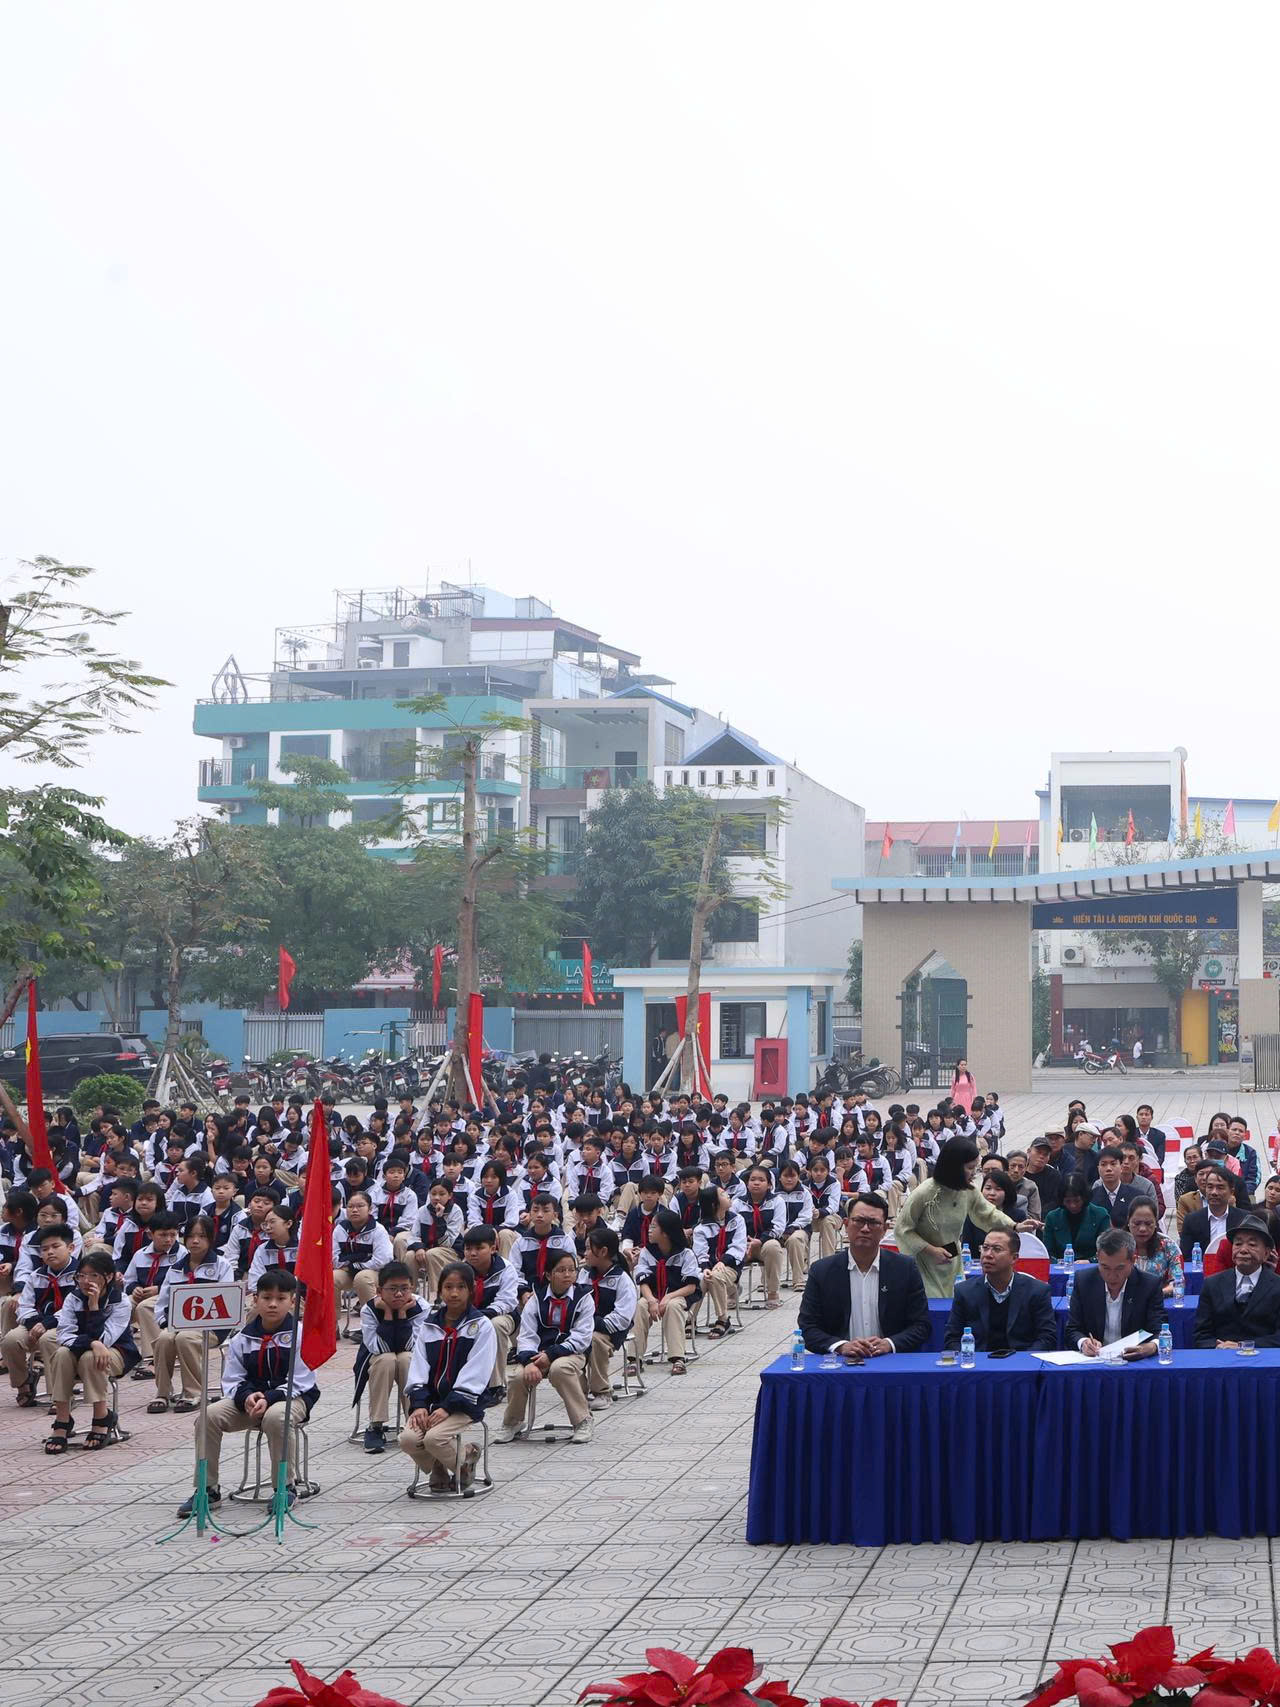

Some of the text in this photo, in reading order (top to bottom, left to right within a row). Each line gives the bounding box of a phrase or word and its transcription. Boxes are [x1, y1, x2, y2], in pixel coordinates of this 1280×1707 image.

[1072, 911, 1198, 924] HIỀN TÀI LÀ NGUYÊN KHÍ QUỐC GIA
[182, 1294, 232, 1321] 6A
